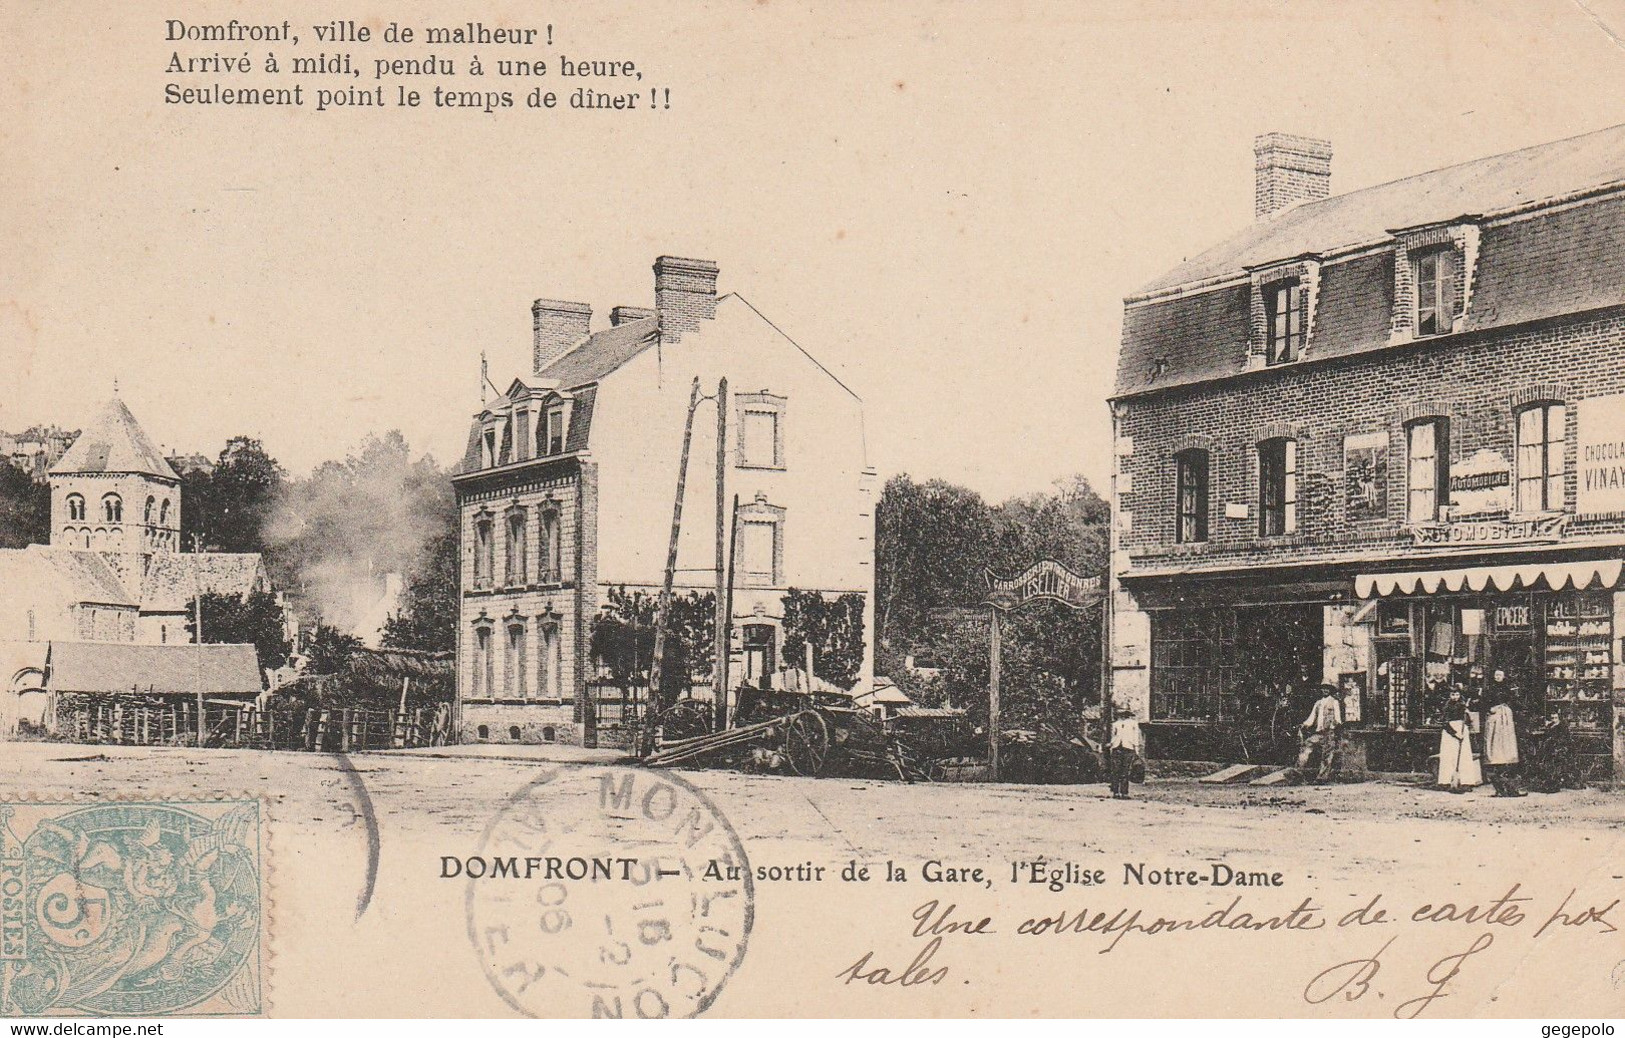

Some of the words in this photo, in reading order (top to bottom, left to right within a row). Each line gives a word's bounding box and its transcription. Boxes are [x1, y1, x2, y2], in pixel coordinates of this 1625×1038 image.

[1022, 570, 1071, 601] LESELLIER
[2, 864, 24, 956] POSTES
[912, 899, 997, 938] Une
[1016, 894, 1327, 955] correspondante
[1338, 894, 1389, 928] de
[1411, 883, 1534, 927] cartes
